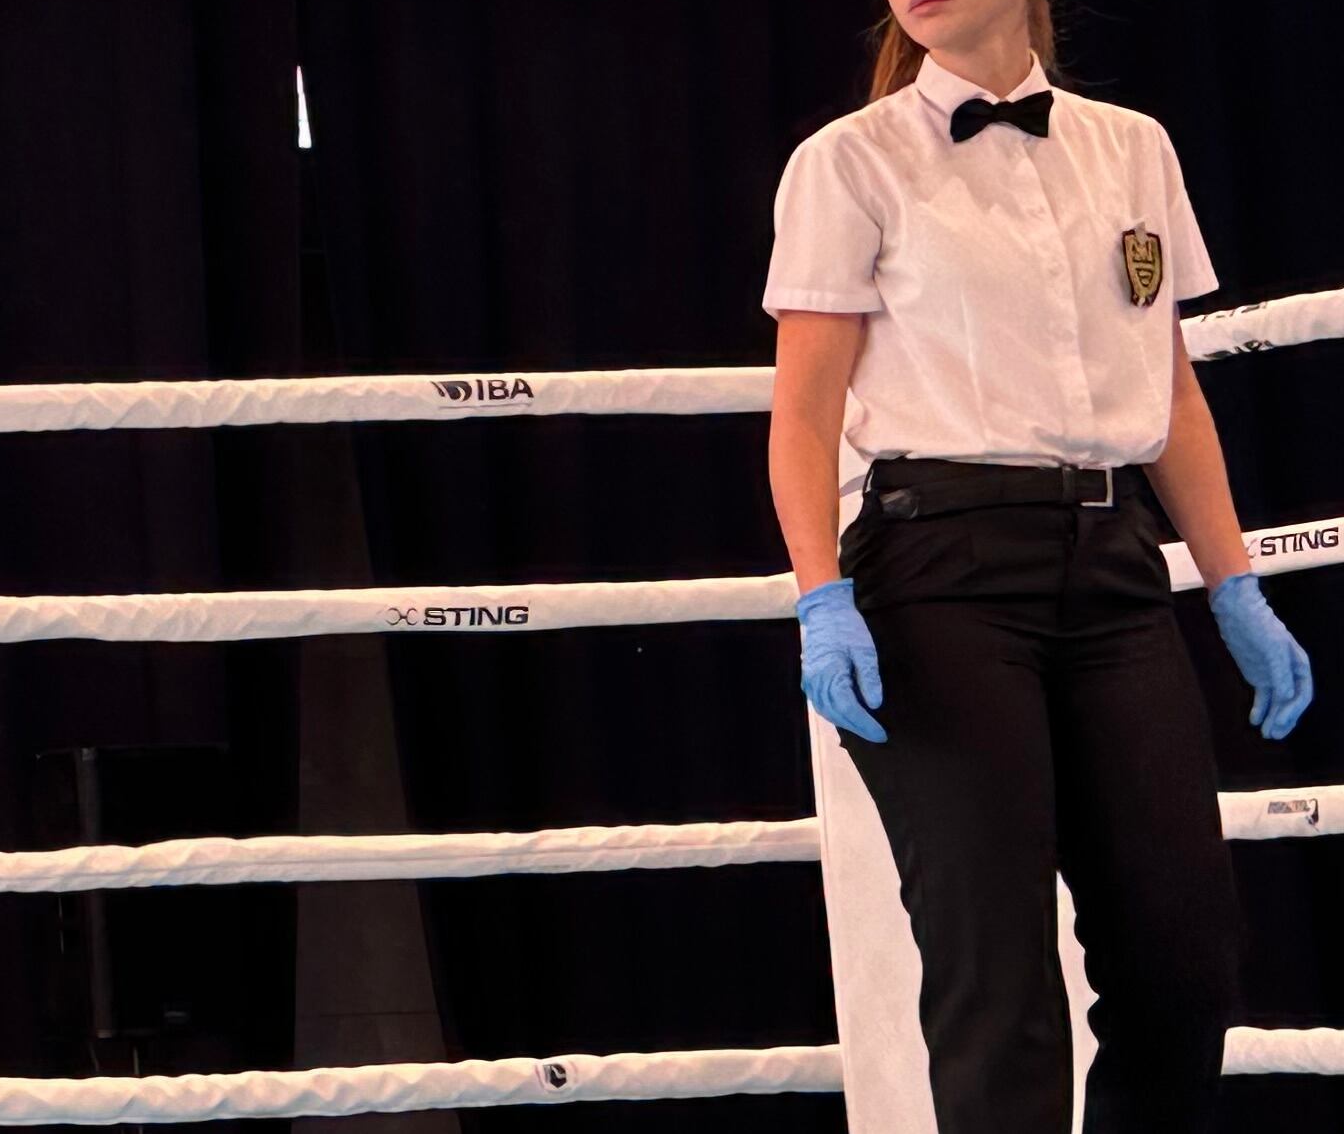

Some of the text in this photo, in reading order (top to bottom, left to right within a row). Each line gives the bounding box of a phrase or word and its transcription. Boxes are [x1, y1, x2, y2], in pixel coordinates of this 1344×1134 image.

[475, 378, 534, 401] IBA
[1260, 526, 1339, 556] STING
[423, 606, 529, 626] STING
